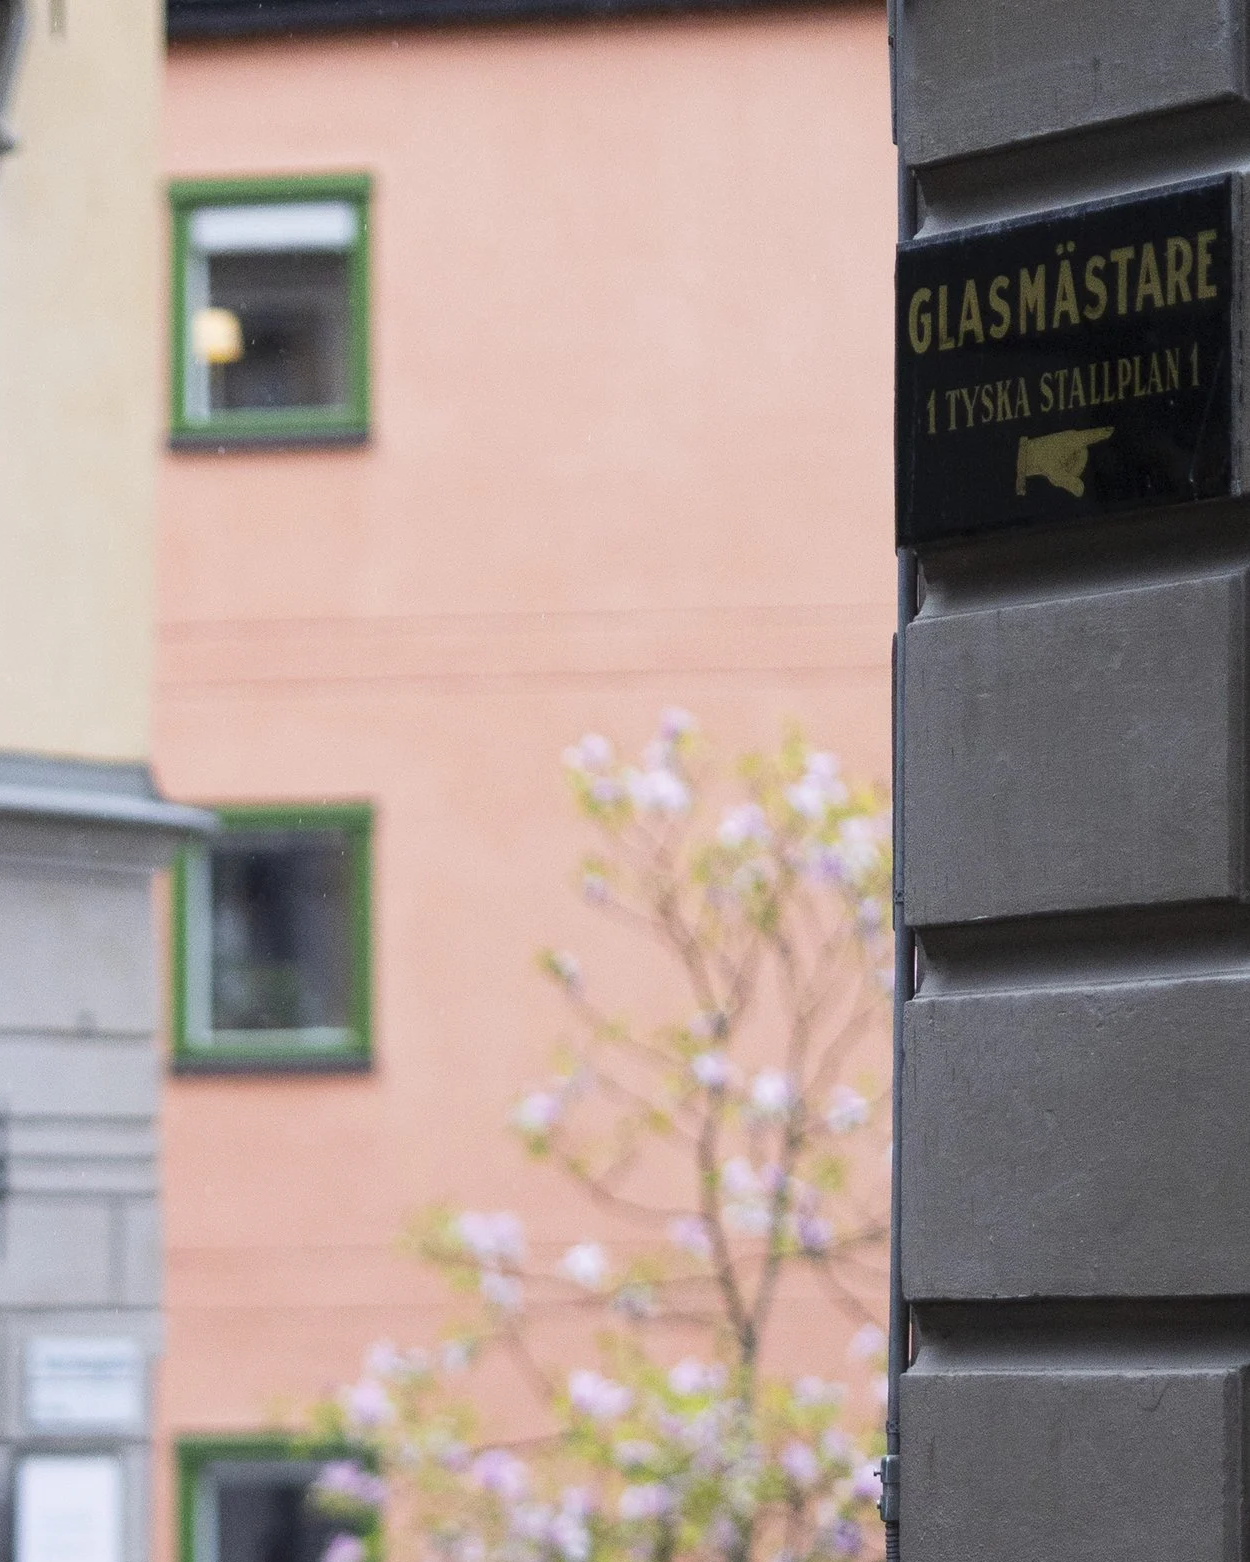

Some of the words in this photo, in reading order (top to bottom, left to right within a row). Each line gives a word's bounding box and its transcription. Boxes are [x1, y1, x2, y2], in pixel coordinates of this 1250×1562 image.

[908, 228, 1218, 354] GLASMÄSTARE
[945, 377, 1032, 431] TYSKA
[1039, 347, 1181, 413] STALLPLAN
[1189, 341, 1201, 387] 1
